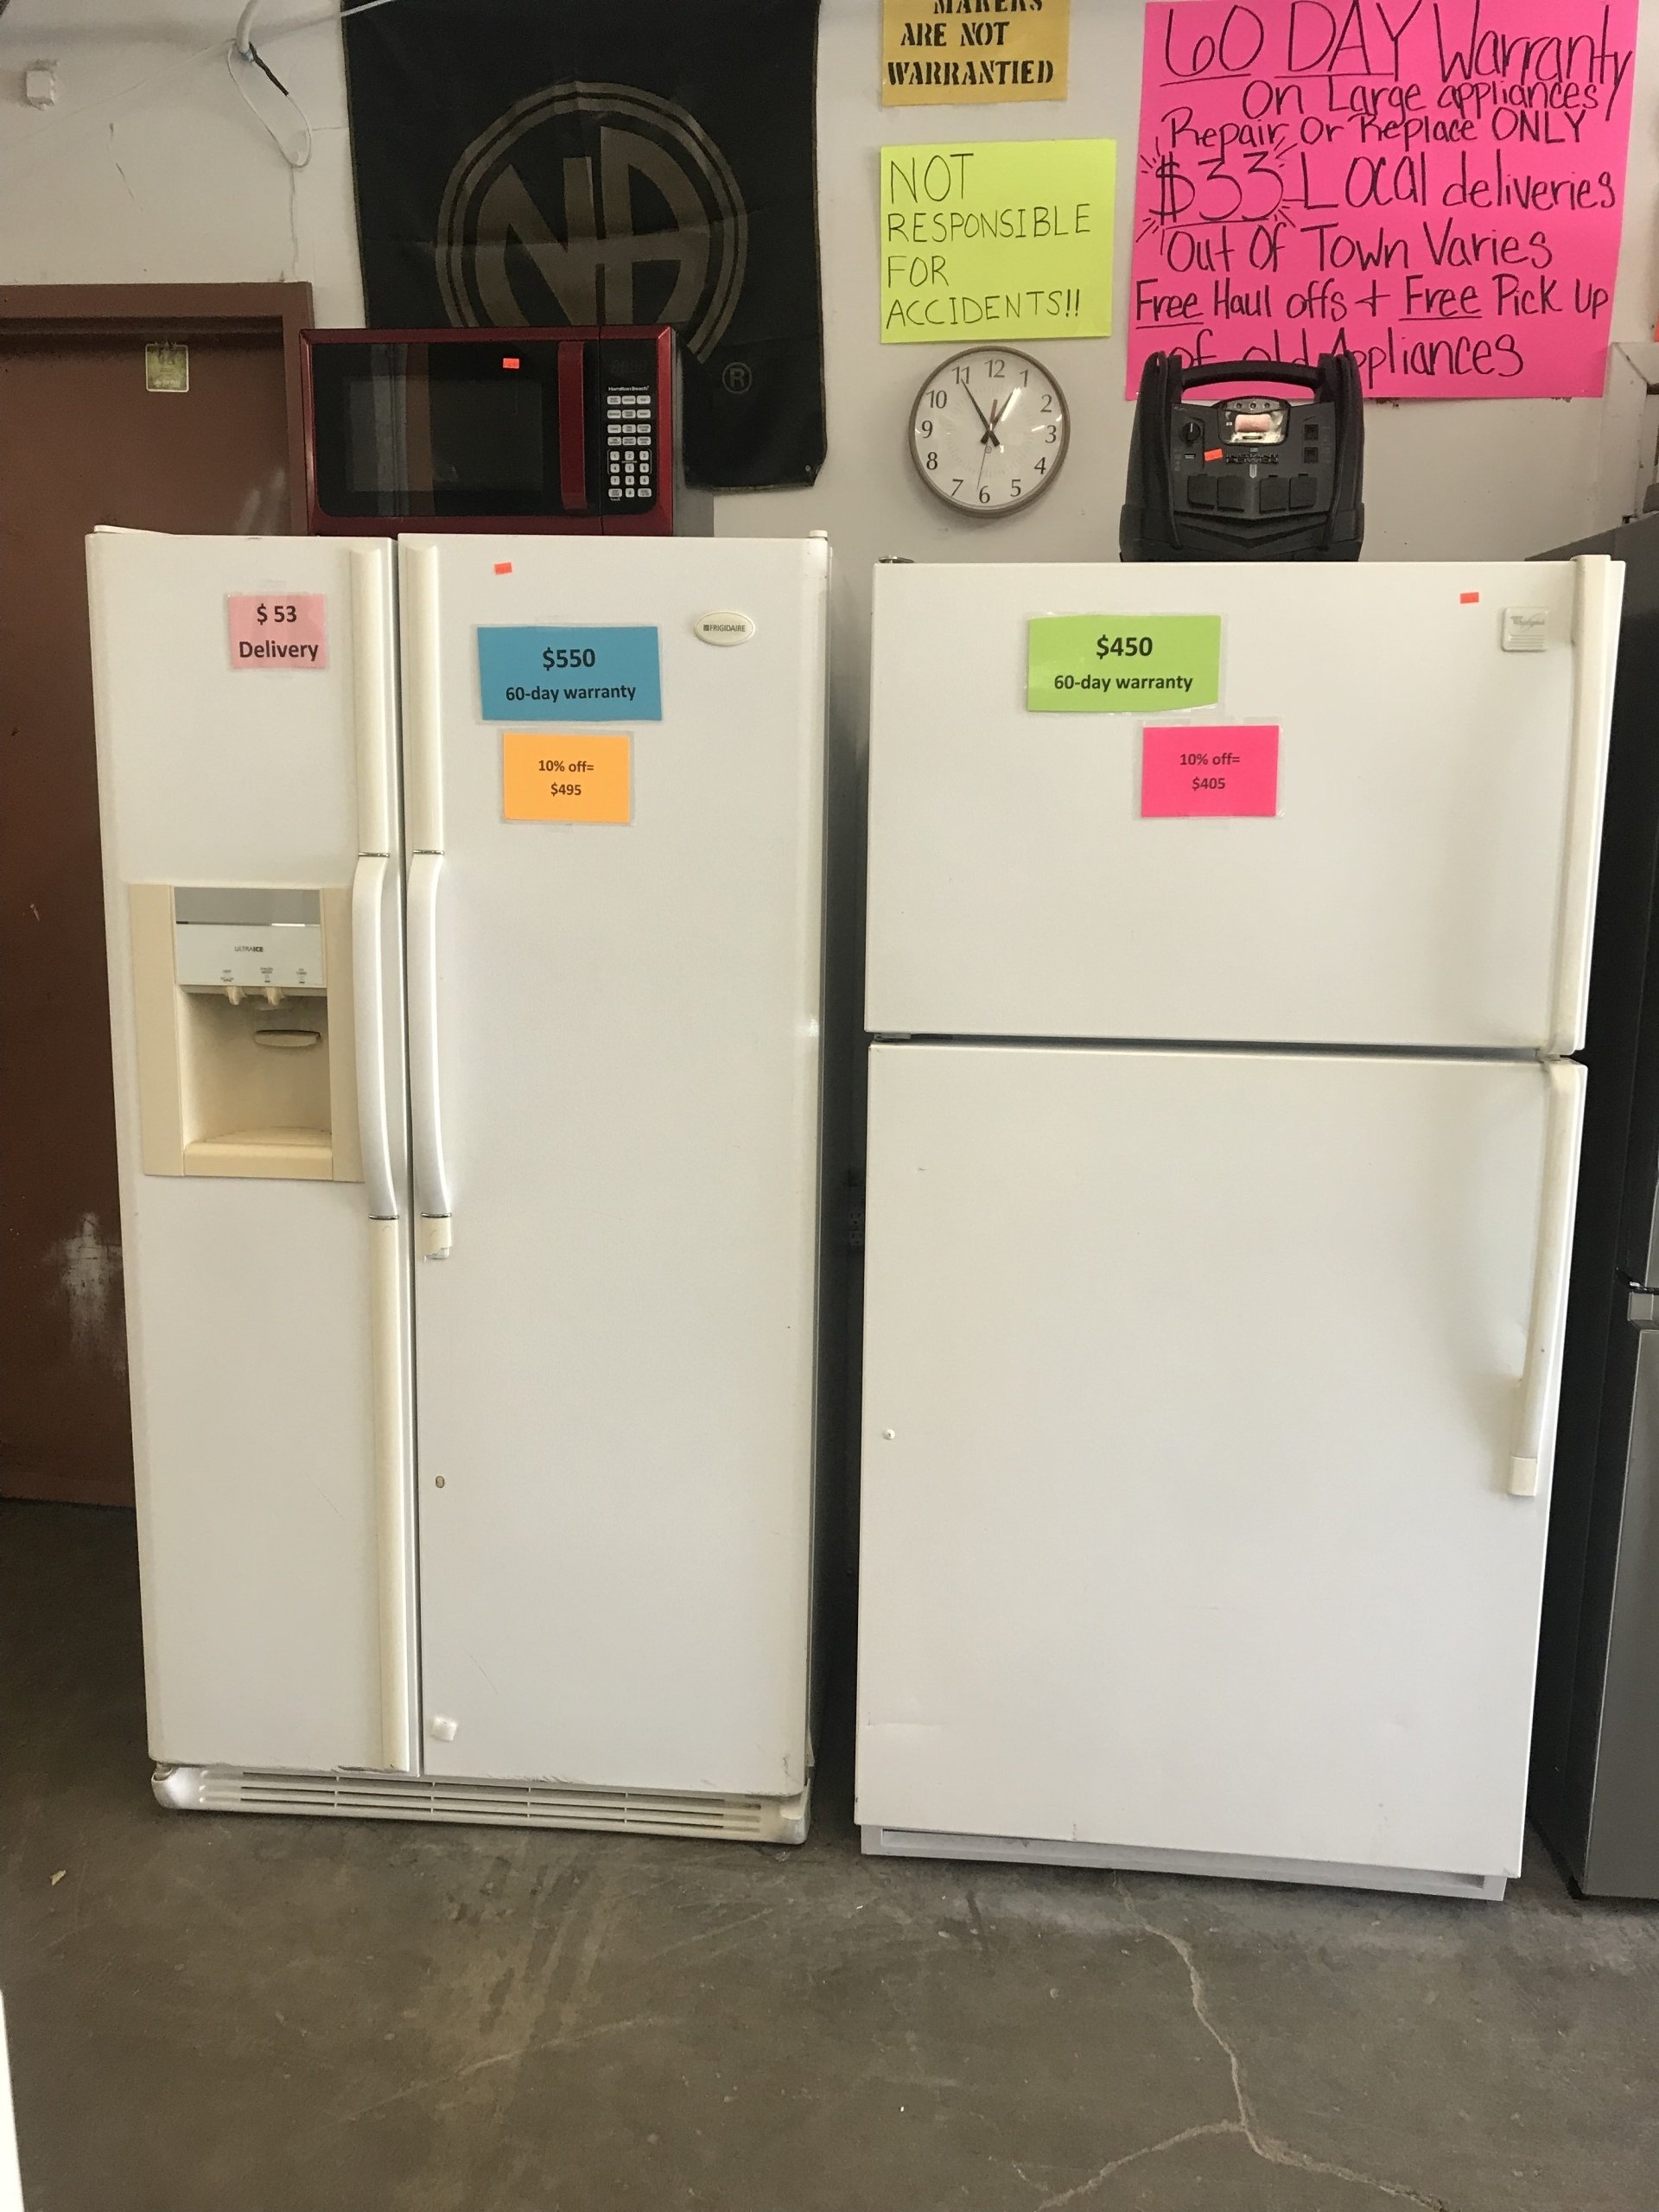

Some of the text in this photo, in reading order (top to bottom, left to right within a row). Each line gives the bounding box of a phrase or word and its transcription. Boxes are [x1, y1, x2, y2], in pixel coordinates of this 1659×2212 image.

[899, 22, 1011, 47] ARE NOT
[1164, 0, 1633, 121] 60 DAY Warranty
[887, 60, 1054, 86] WARRANTIED
[1243, 75, 1599, 127] On Large appliances
[1160, 106, 1586, 162] Repair Or Replace ONLY
[890, 153, 974, 204] NOT
[1148, 151, 1284, 226] $33
[1441, 149, 1617, 211] deliveries
[887, 203, 1090, 243] RESPONSIBLE
[1166, 225, 1236, 272] Out
[1300, 223, 1410, 271] Town
[1422, 217, 1554, 270] Varies
[887, 255, 950, 288] FOR
[1135, 277, 1205, 322] Free
[1214, 276, 1272, 320] Haul
[1286, 277, 1348, 322] offs
[1405, 274, 1482, 318] Free
[886, 289, 1081, 330] ACCIDENTS!!
[951, 365, 970, 385] 11
[983, 359, 1006, 378] 12
[1020, 369, 1029, 388] 1
[925, 389, 948, 409] 10
[1040, 393, 1052, 413] 2
[921, 420, 933, 439] 9
[1045, 424, 1057, 444] 3
[925, 452, 938, 471] 8
[1033, 456, 1046, 475] 4
[951, 478, 964, 497] 7
[978, 485, 991, 504] 6
[1010, 479, 1021, 498] 5
[257, 603, 297, 626] $ 53
[709, 624, 746, 632] FRIGIDAIRE
[238, 639, 319, 662] Delivery
[1096, 634, 1154, 660] $450
[542, 646, 596, 672] $550
[505, 684, 637, 702] 60-day warranty
[1053, 674, 1193, 693] 60-day warranty
[537, 760, 594, 773] 10% off=
[1179, 752, 1241, 766] 10% off=
[550, 781, 582, 797] $495
[1192, 777, 1226, 791] $405
